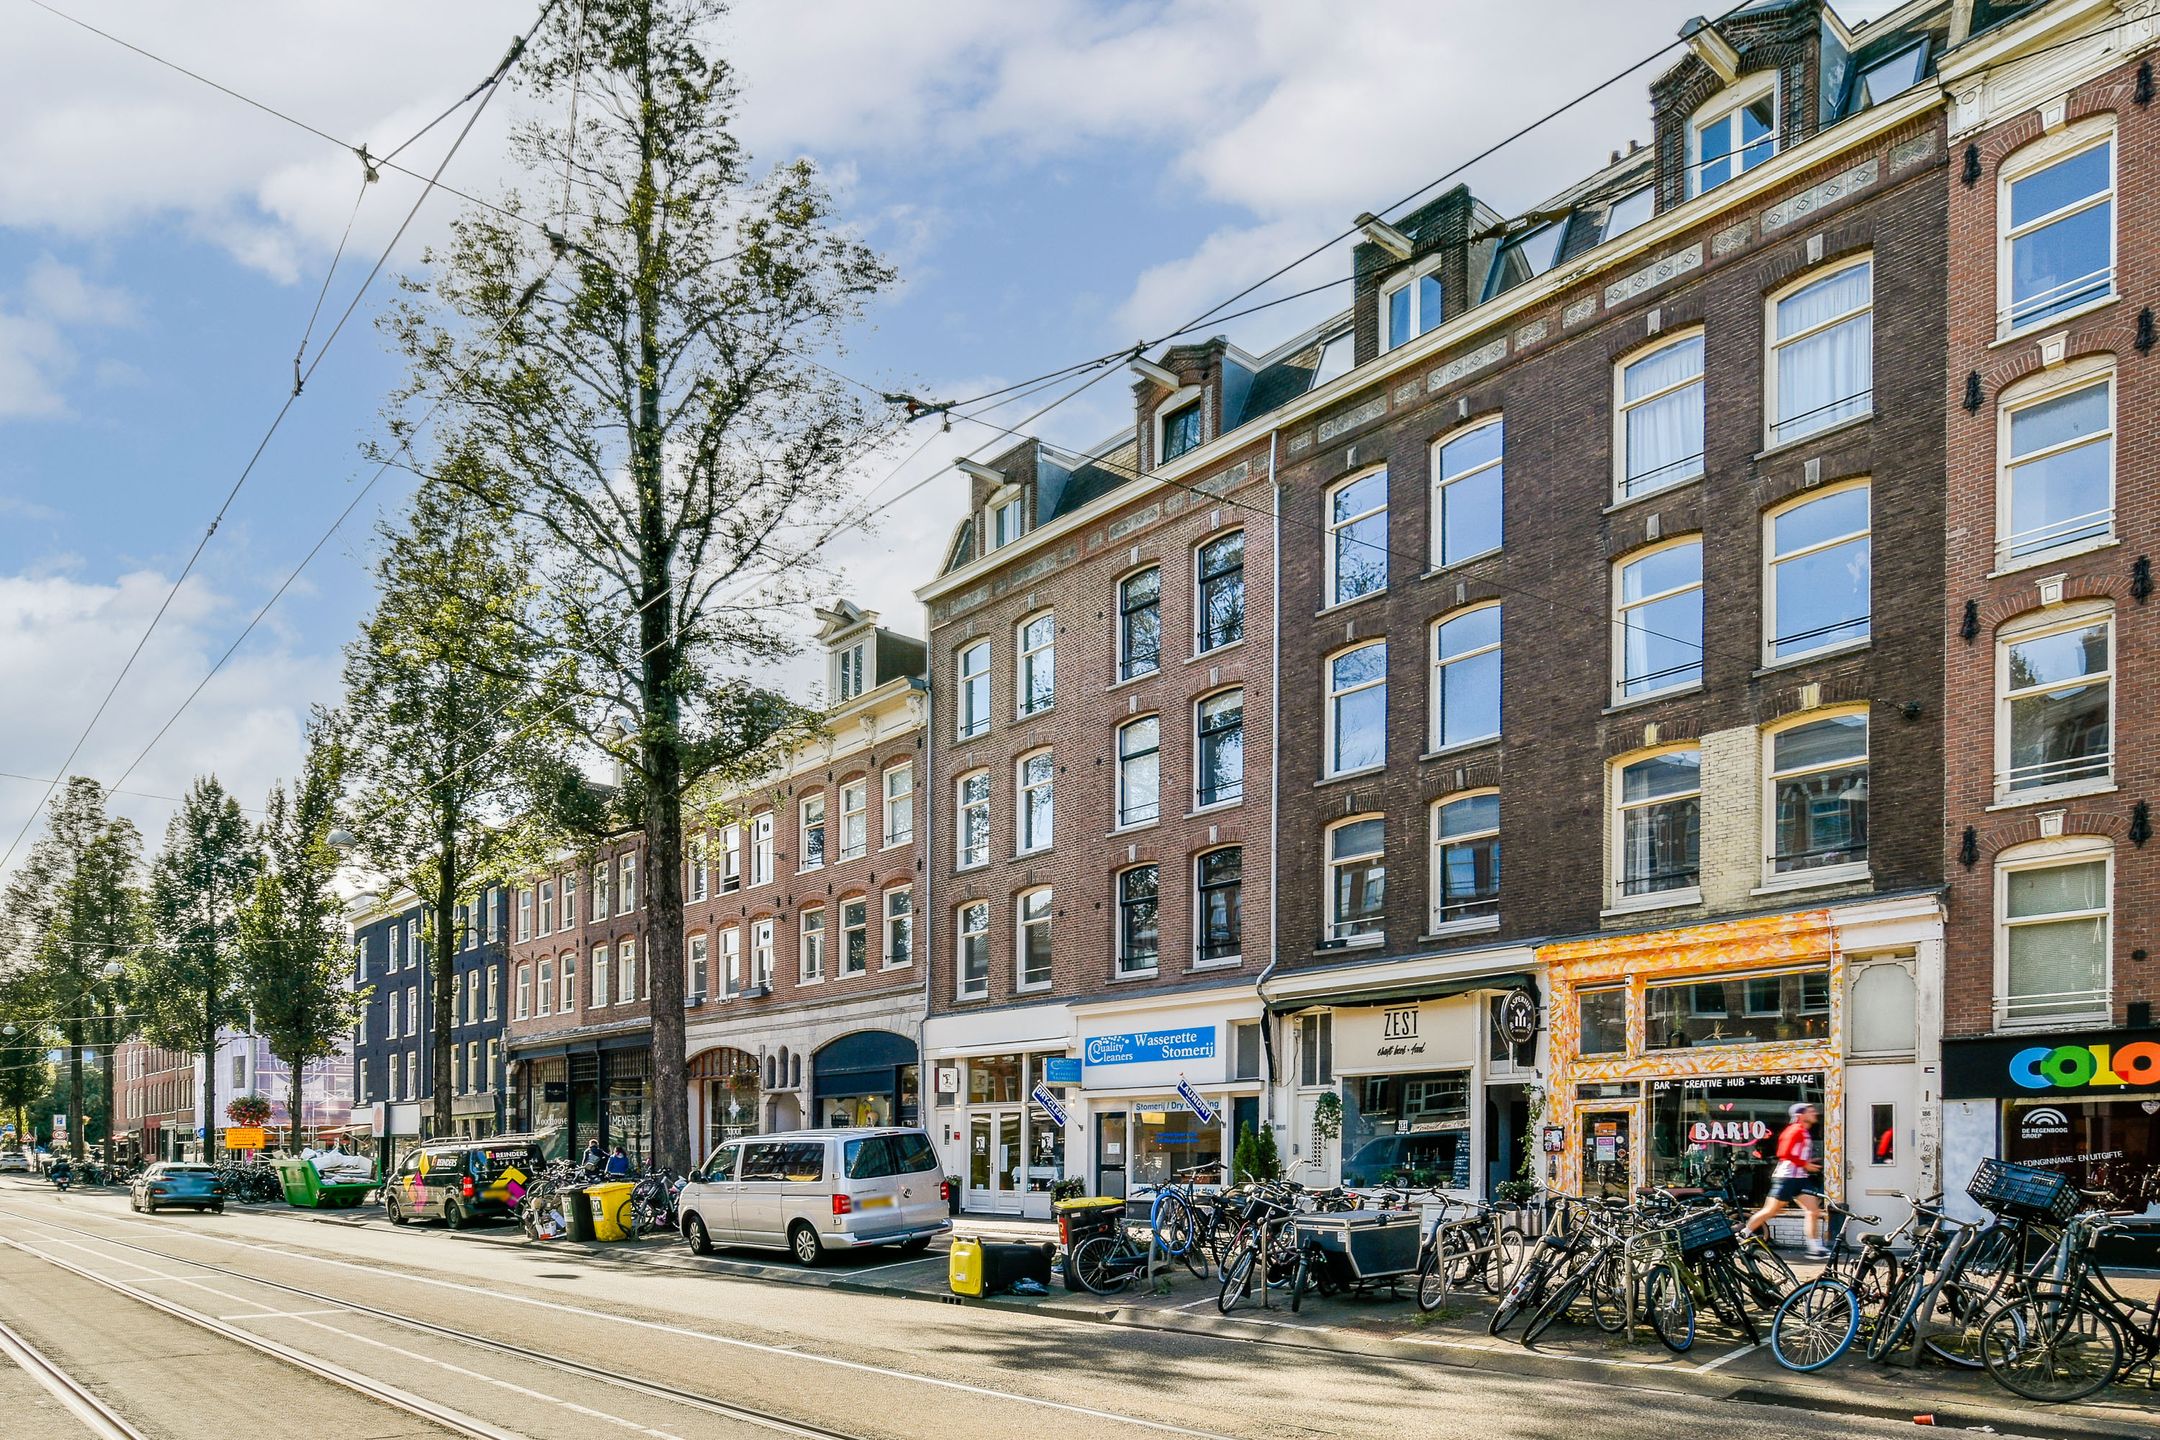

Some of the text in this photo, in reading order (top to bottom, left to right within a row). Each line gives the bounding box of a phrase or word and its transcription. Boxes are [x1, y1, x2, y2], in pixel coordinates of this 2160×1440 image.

[1384, 1010, 1419, 1037] ZEST
[1134, 1032, 1197, 1047] Wasserette
[1093, 1042, 1124, 1055] Quality
[1162, 1042, 1214, 1058] Stomerij
[1654, 1081, 1670, 1090] BAR
[1684, 1079, 1722, 1089] CREATIVE
[1727, 1078, 1745, 1087] HUB
[1760, 1076, 1782, 1085] SAFE
[1786, 1075, 1814, 1084] SPACE
[1036, 1088, 1067, 1121] DRY-CLEAN
[1136, 1103, 1166, 1111] Stomerij
[1171, 1101, 1184, 1109] Dry
[1180, 1081, 1211, 1117] LAUNDRY
[1695, 1120, 1766, 1140] BARIO
[496, 1150, 528, 1159] REINDERS
[2078, 1154, 2089, 1162] EN
[2089, 1150, 2123, 1161] UITGIFTE
